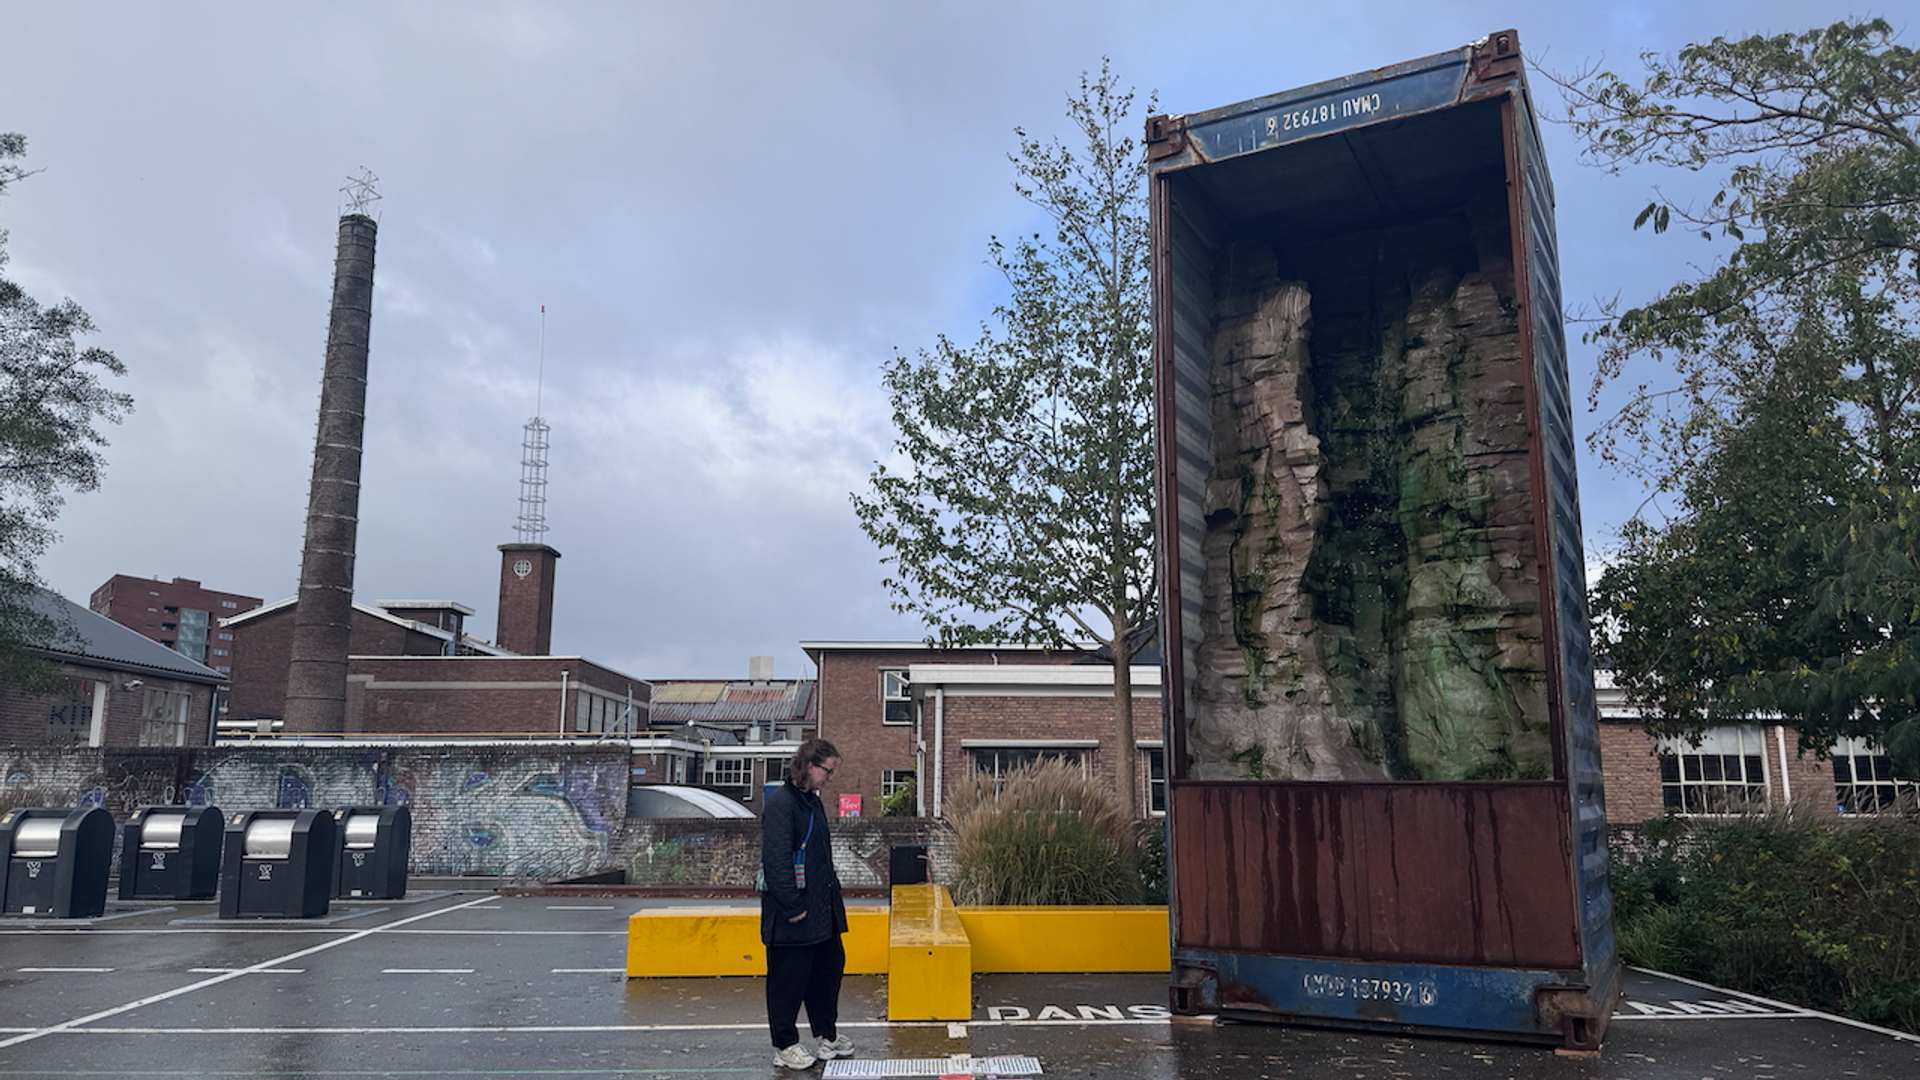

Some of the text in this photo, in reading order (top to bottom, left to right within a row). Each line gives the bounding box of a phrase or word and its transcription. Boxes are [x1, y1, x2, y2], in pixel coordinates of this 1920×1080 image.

[1266, 93, 1380, 135] CMAU 187932 6
[986, 1004, 1172, 1021] DANS
